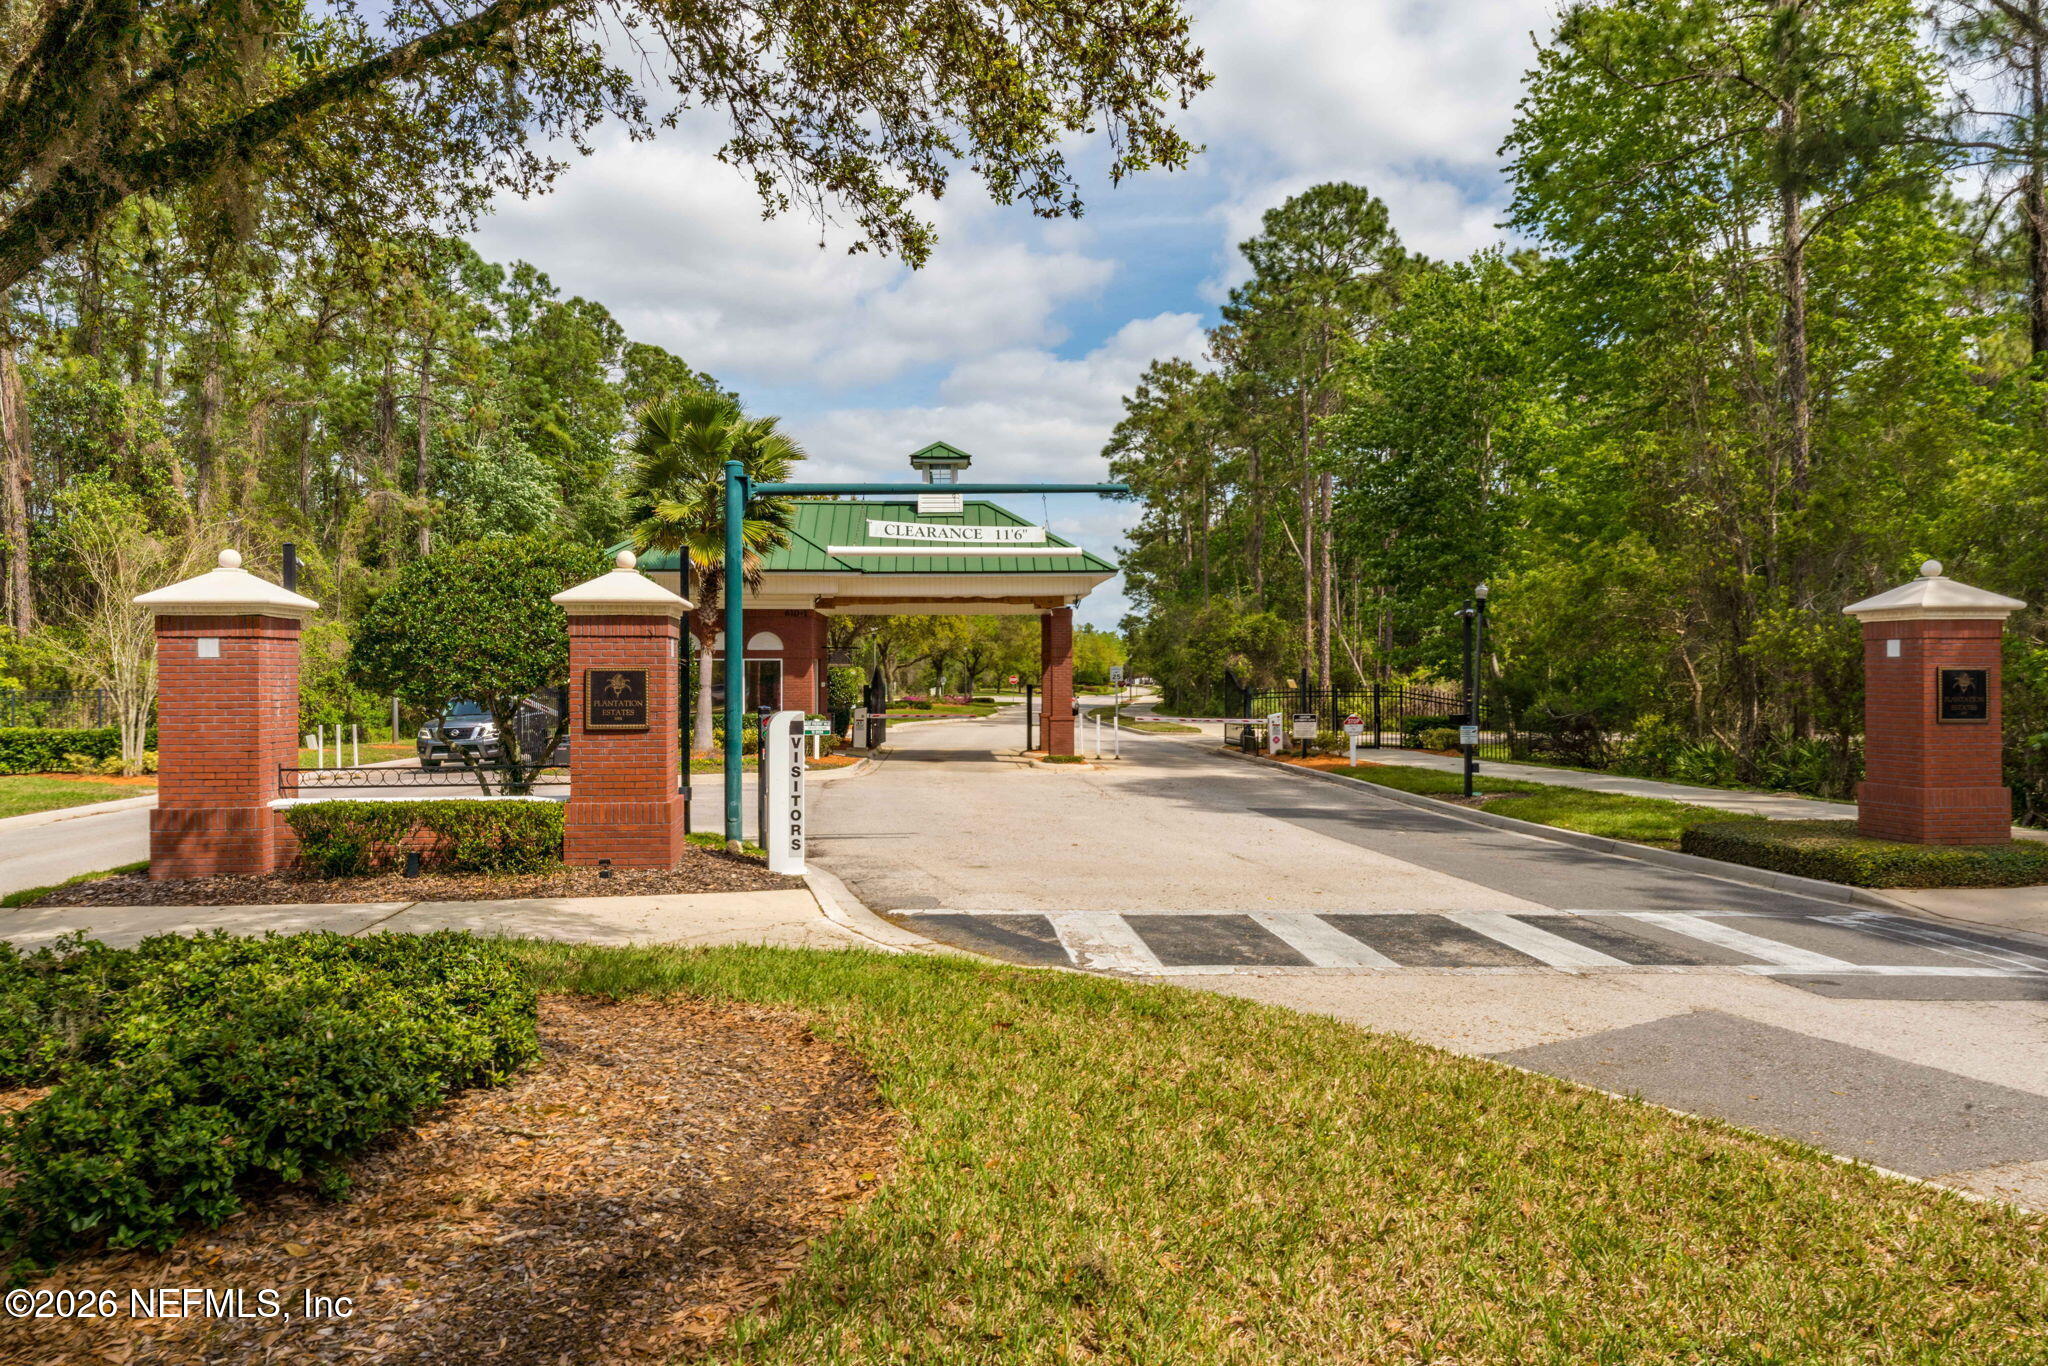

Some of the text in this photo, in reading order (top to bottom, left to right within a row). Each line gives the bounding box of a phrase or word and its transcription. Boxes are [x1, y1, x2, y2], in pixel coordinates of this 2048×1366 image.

[884, 523, 1028, 540] CLEARANCE 11'6"
[790, 738, 802, 851] VISITORS
